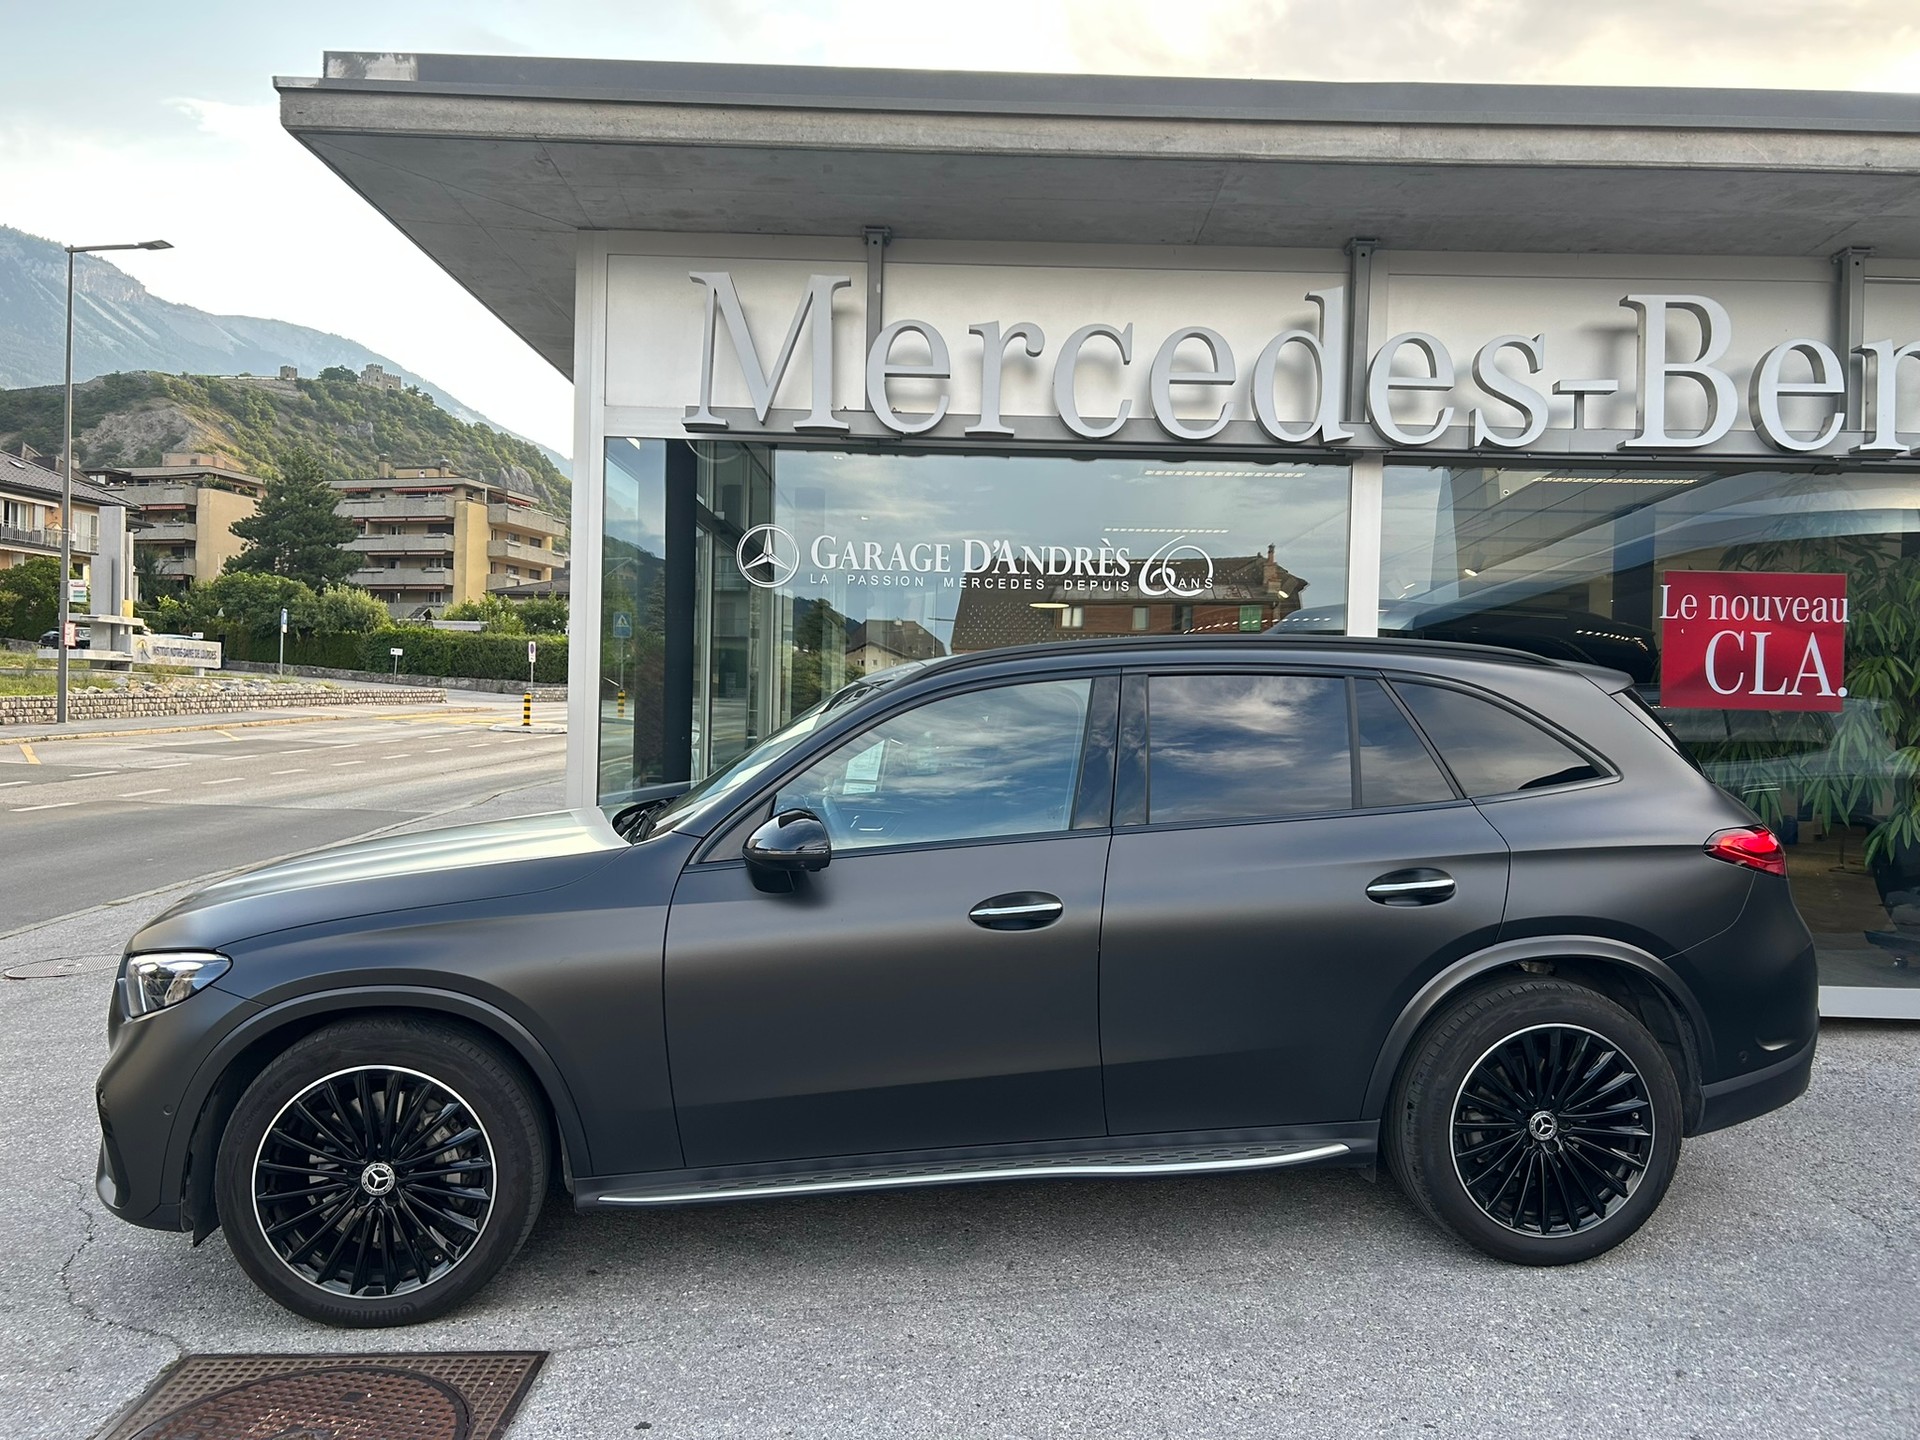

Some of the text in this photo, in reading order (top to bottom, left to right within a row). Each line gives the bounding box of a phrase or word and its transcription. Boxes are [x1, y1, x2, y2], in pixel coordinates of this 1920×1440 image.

[810, 535, 1214, 597] LA PASSION MERCEDES DEPUIS 60 ANS
[811, 535, 951, 573] GARAGE
[1660, 584, 1850, 623] Le nouveau
[1705, 630, 1848, 698] CLA.
